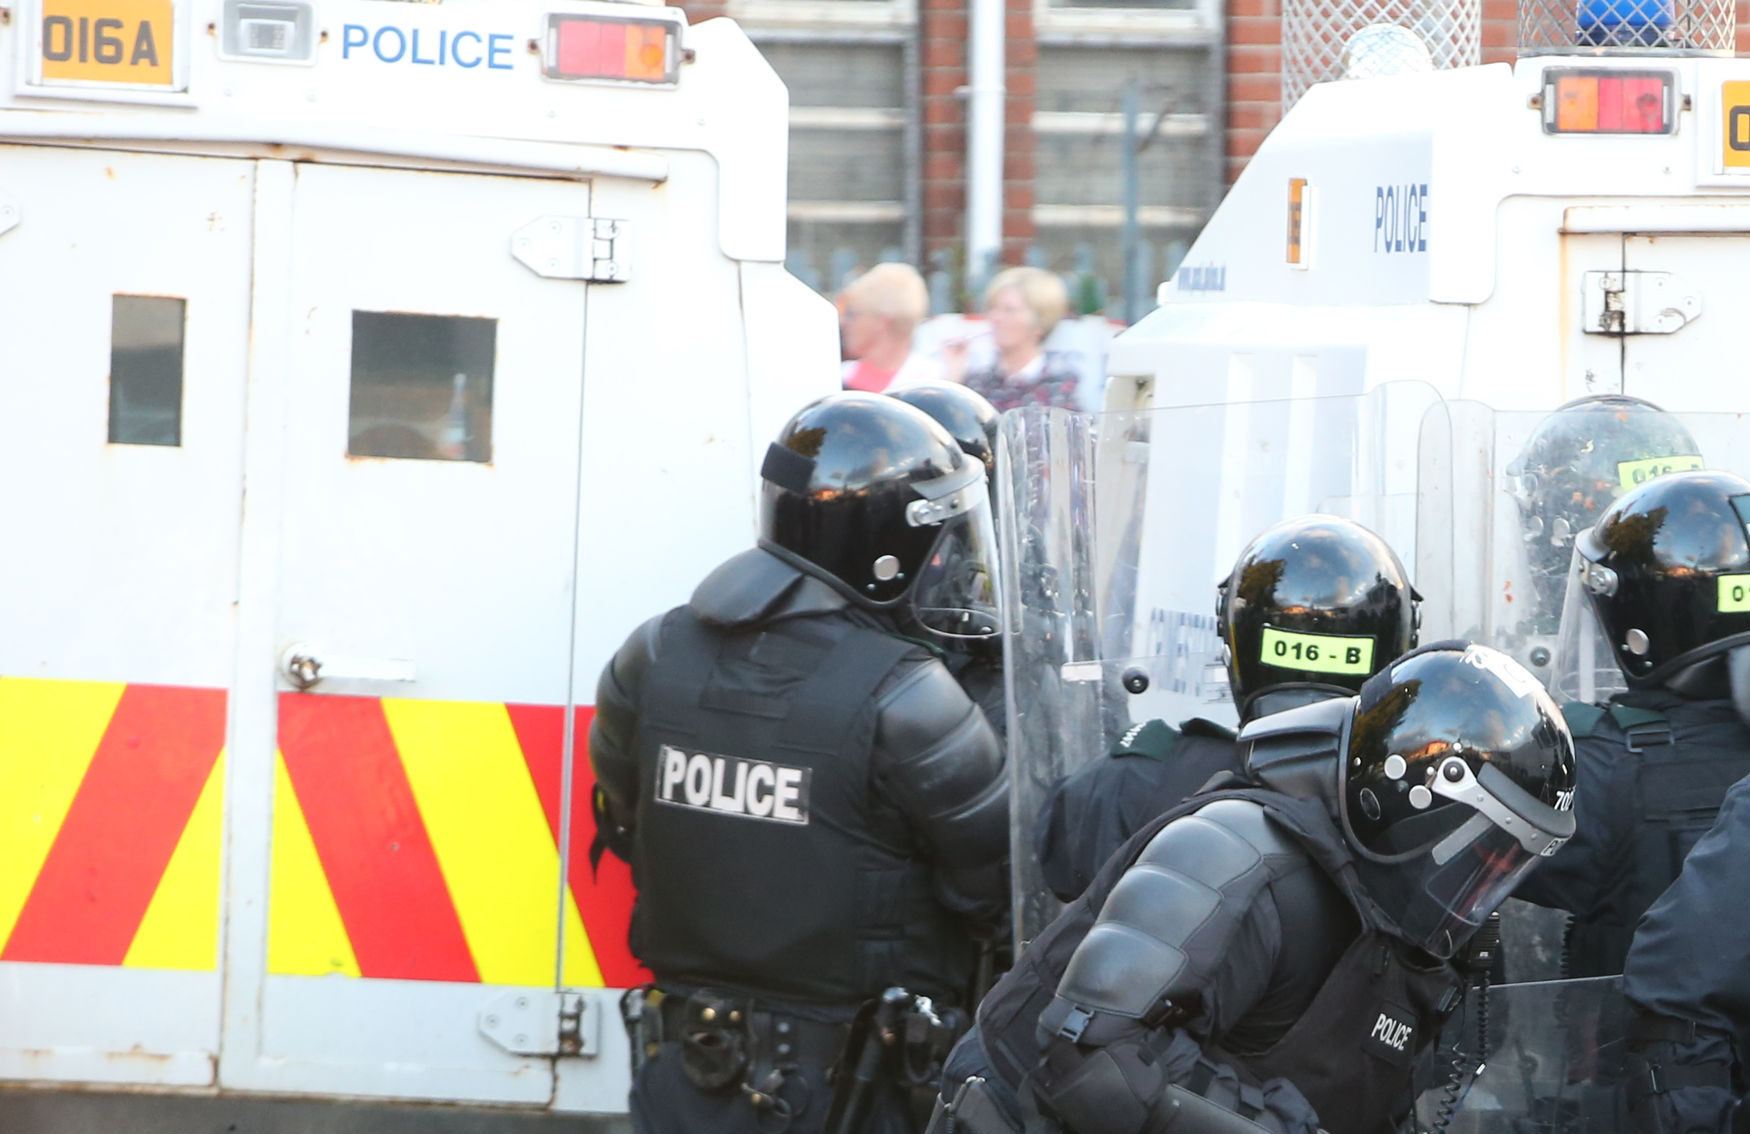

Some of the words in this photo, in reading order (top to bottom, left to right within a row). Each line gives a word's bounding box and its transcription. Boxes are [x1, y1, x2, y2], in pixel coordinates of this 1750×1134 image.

[342, 23, 515, 70] POLICE
[1375, 184, 1428, 253] POLICE
[662, 748, 803, 822] POLICE
[1371, 1013, 1412, 1050] POLICE
